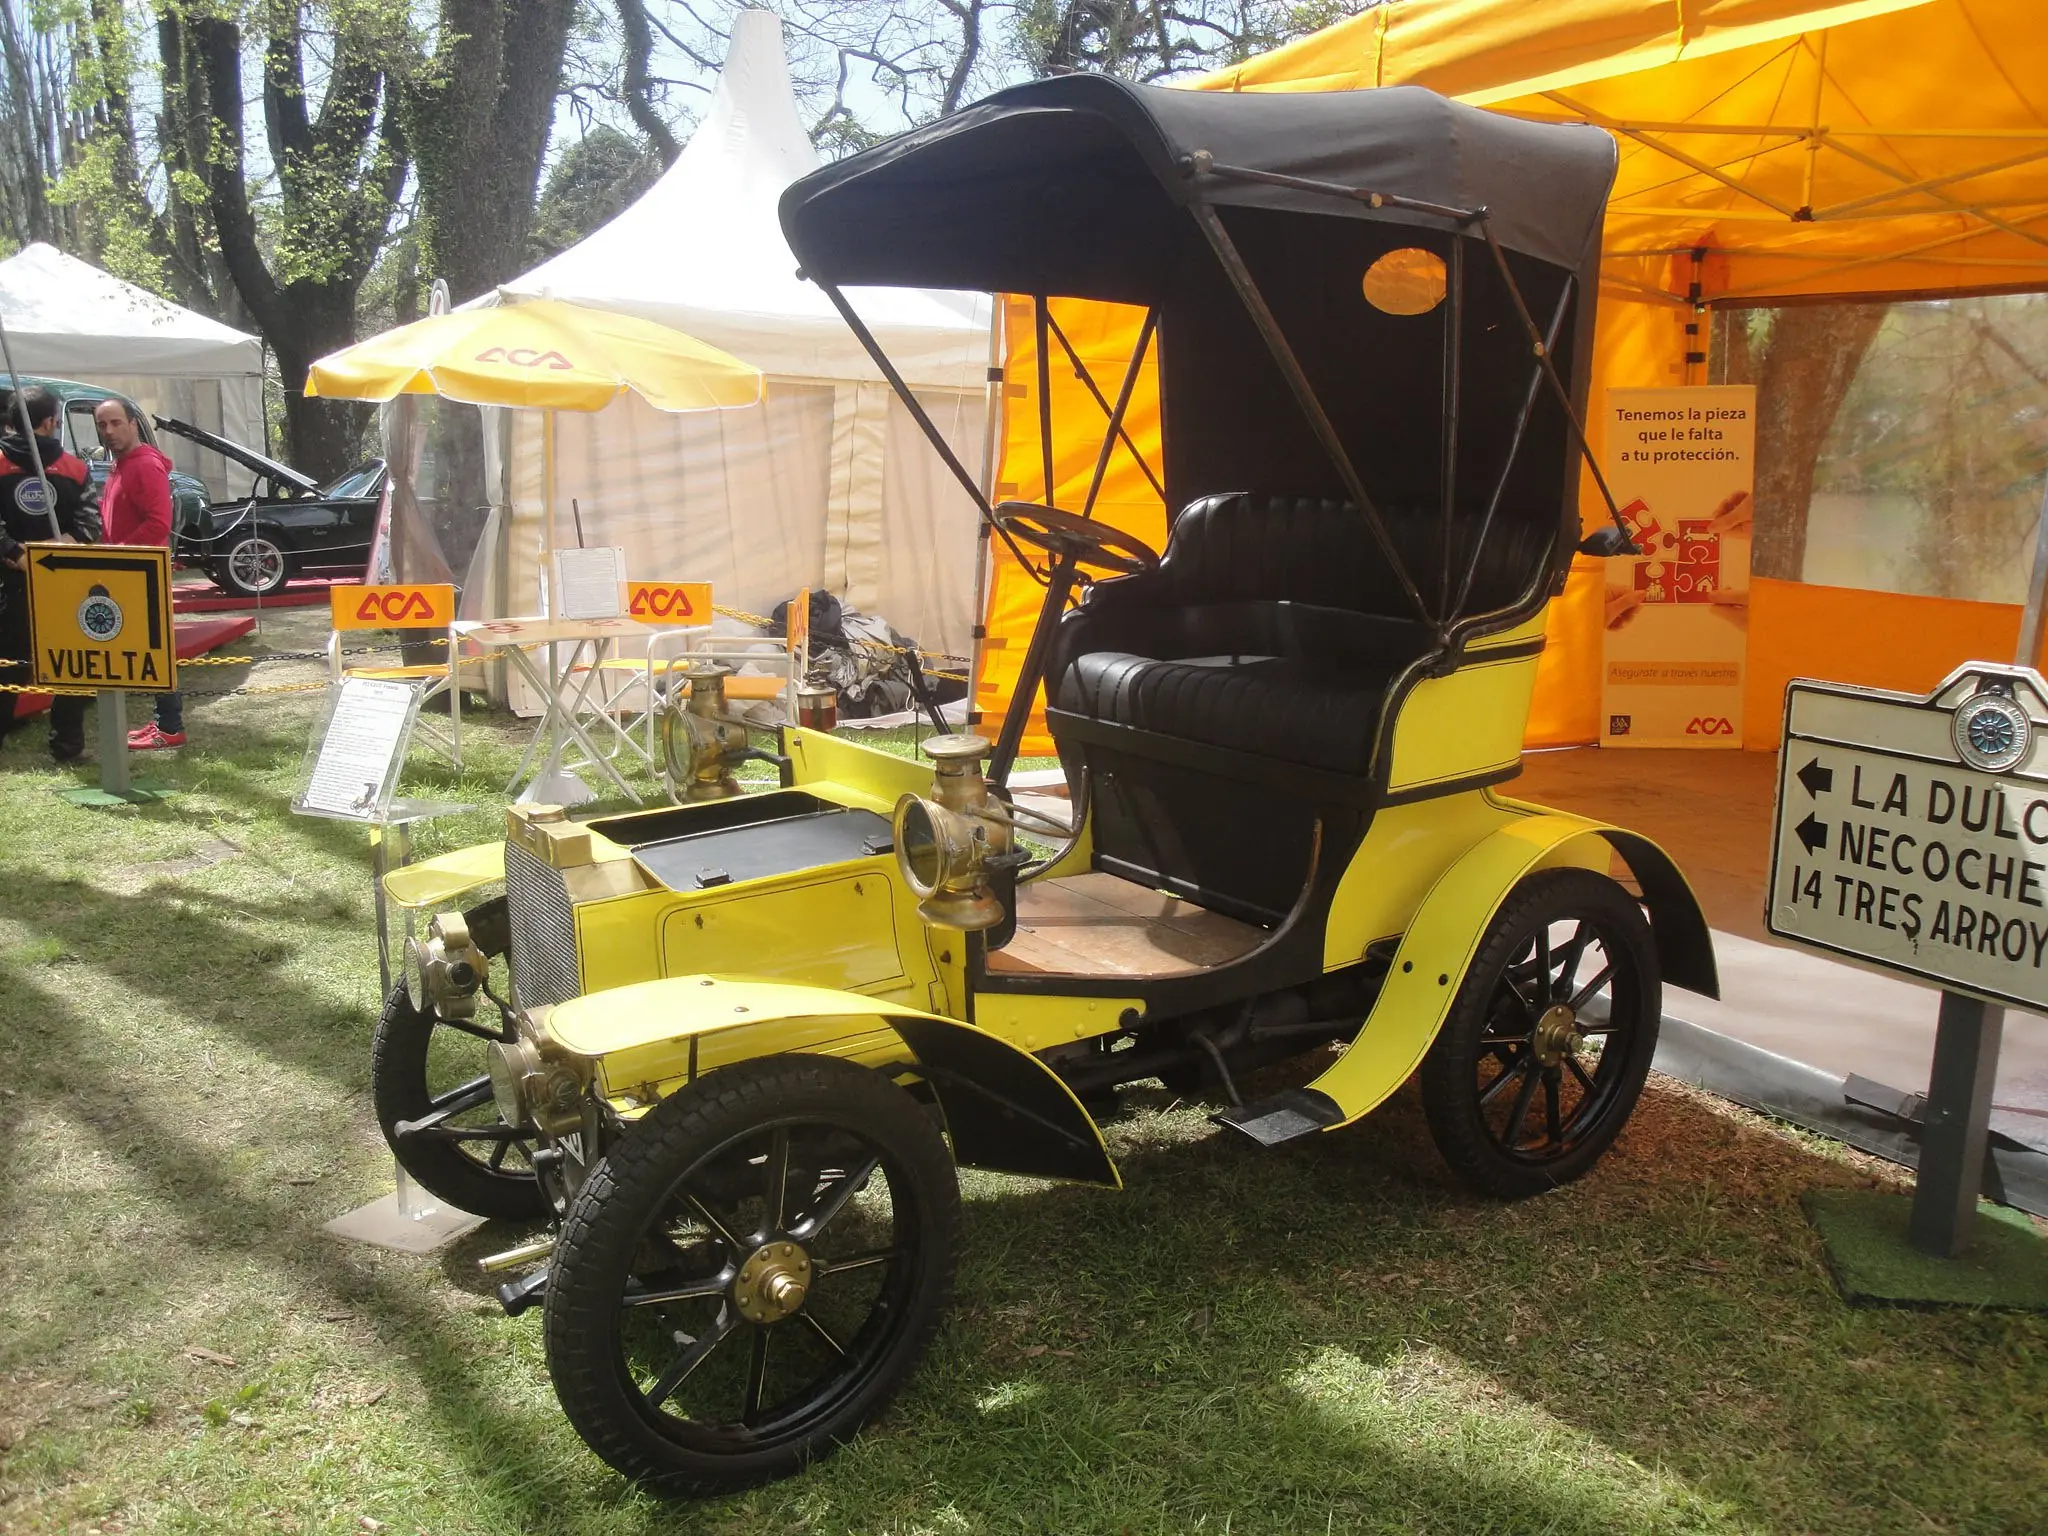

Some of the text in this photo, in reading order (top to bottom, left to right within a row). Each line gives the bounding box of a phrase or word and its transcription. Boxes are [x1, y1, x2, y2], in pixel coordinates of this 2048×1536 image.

[475, 347, 574, 370] ACA
[1616, 407, 1746, 423] Tenemos la pieza
[1638, 428, 1723, 443] que le falta
[1621, 448, 1740, 464] a tu protección.
[356, 590, 435, 622] ACA
[630, 587, 694, 617] ACA
[48, 649, 158, 681] VUELTA
[1685, 717, 1734, 735] ACA
[1851, 765, 1908, 818] LA
[1839, 820, 2047, 908] NECOCHE
[1791, 865, 2048, 968] 14 TRES ARROY
